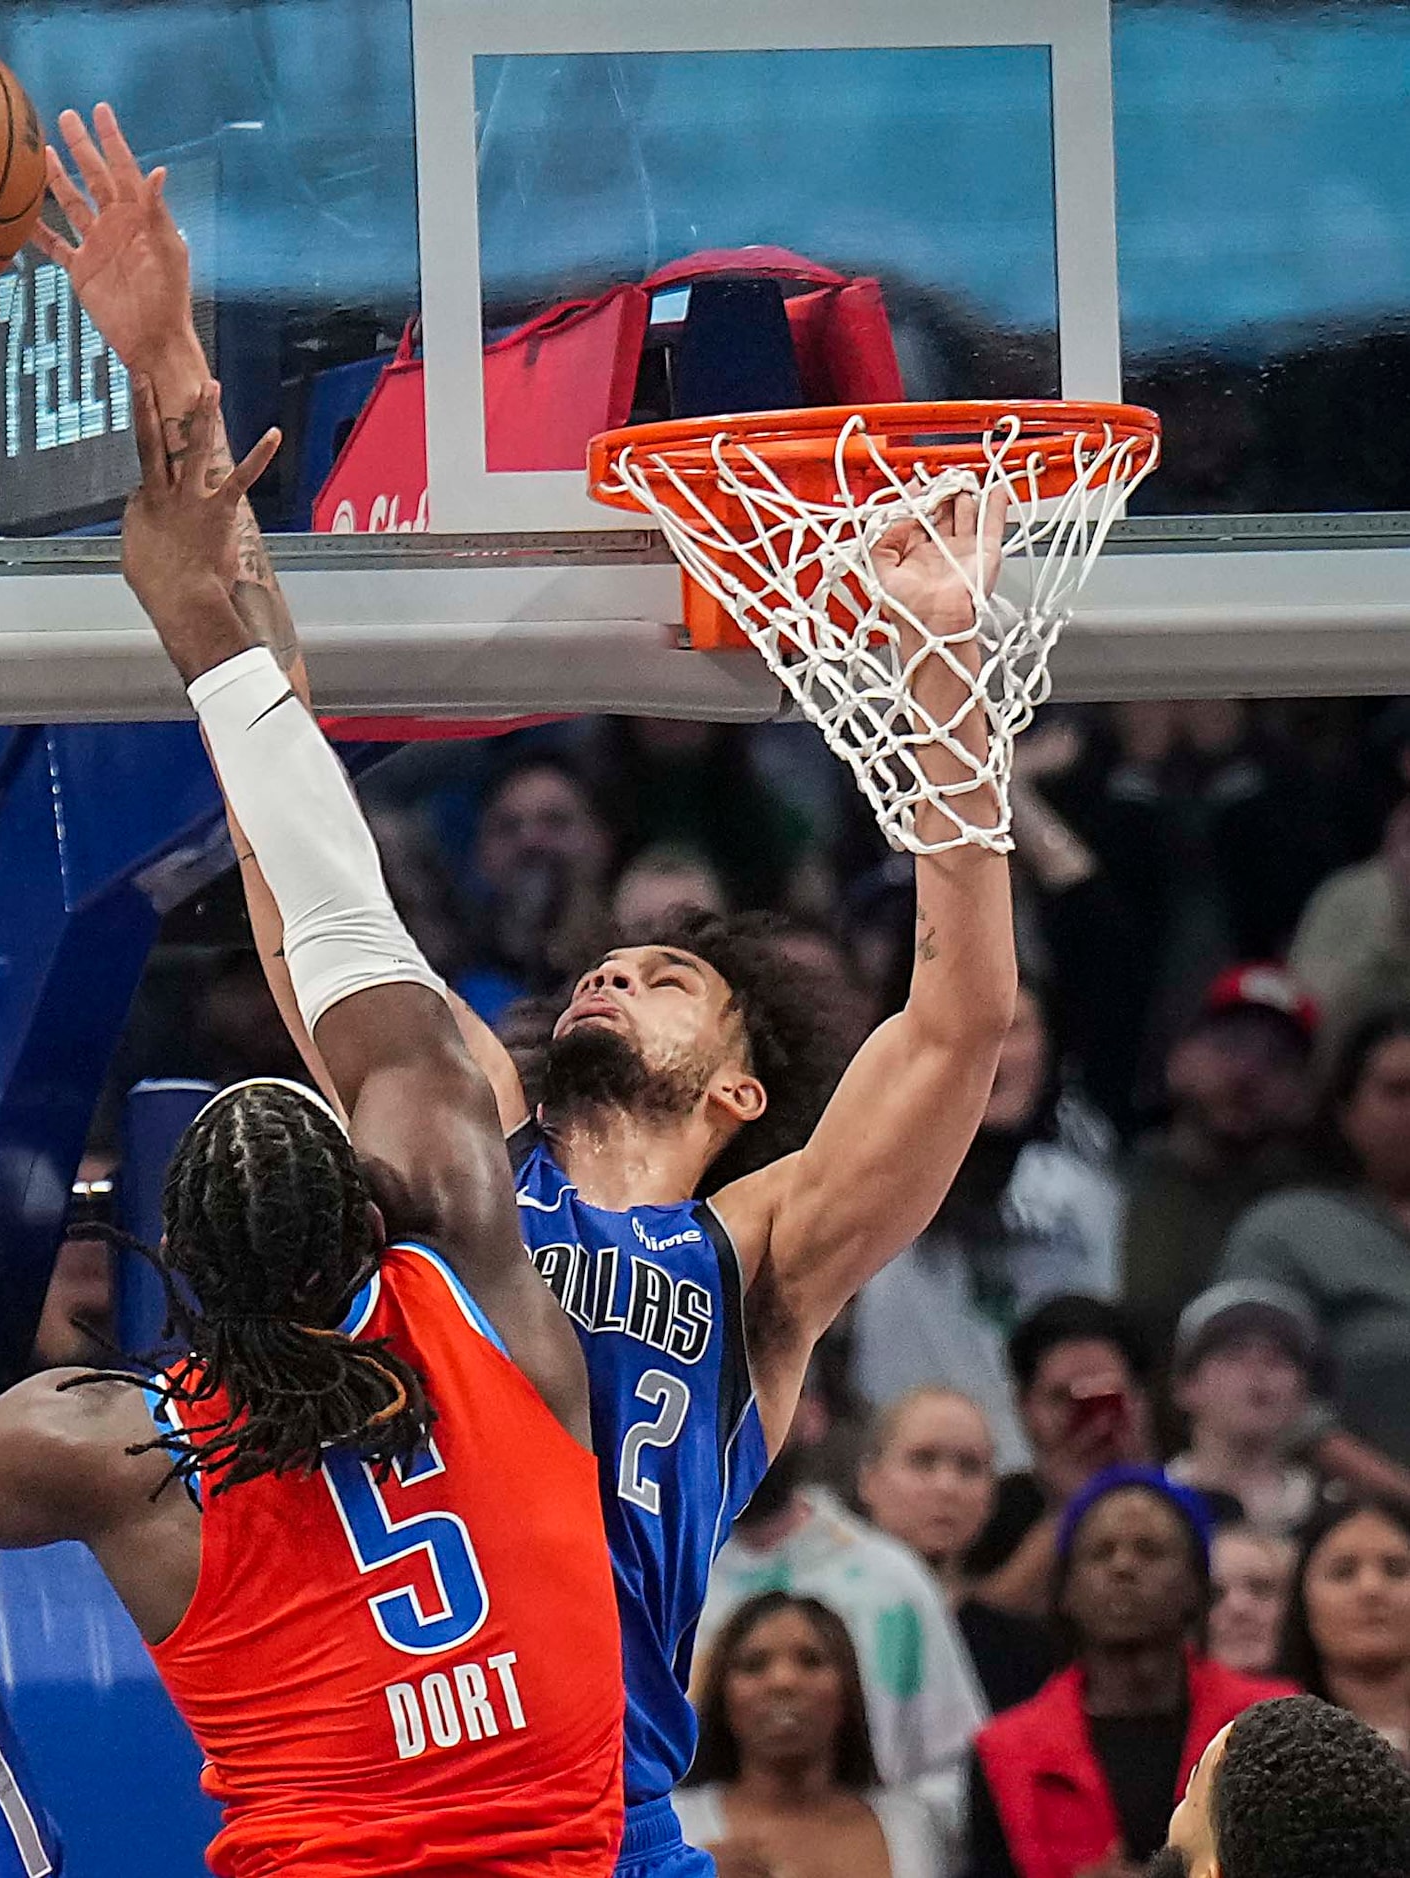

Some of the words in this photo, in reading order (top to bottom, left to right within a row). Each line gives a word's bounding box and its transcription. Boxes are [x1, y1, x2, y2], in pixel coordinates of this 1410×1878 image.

[523, 1242, 713, 1366] ALLAS
[617, 1368, 691, 1516] 2
[320, 1424, 490, 1656] 5
[385, 1651, 527, 1760] DORT
